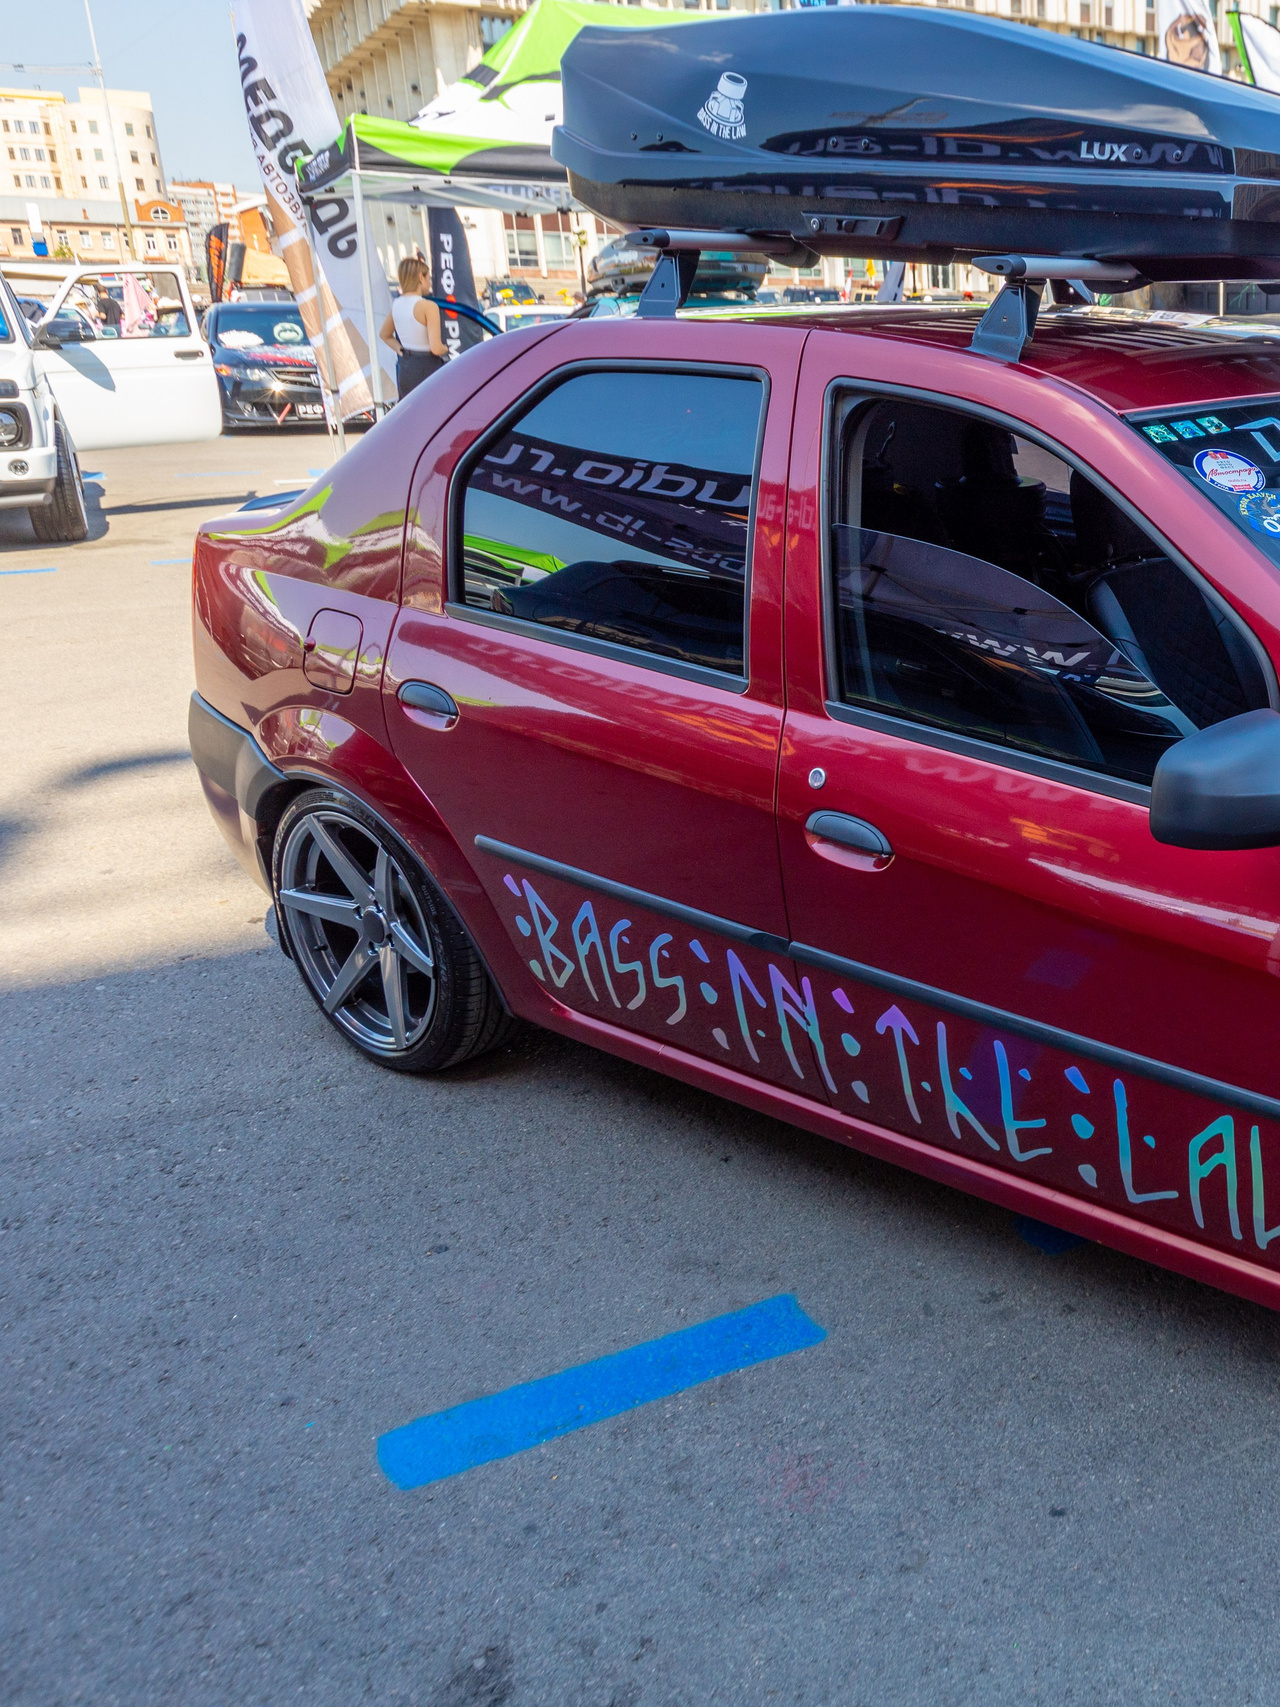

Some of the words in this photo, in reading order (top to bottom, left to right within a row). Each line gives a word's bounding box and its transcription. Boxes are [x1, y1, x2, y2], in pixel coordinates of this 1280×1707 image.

[731, 123, 747, 140] LAW
[1080, 141, 1130, 162] LUX
[521, 878, 687, 1026] BASS
